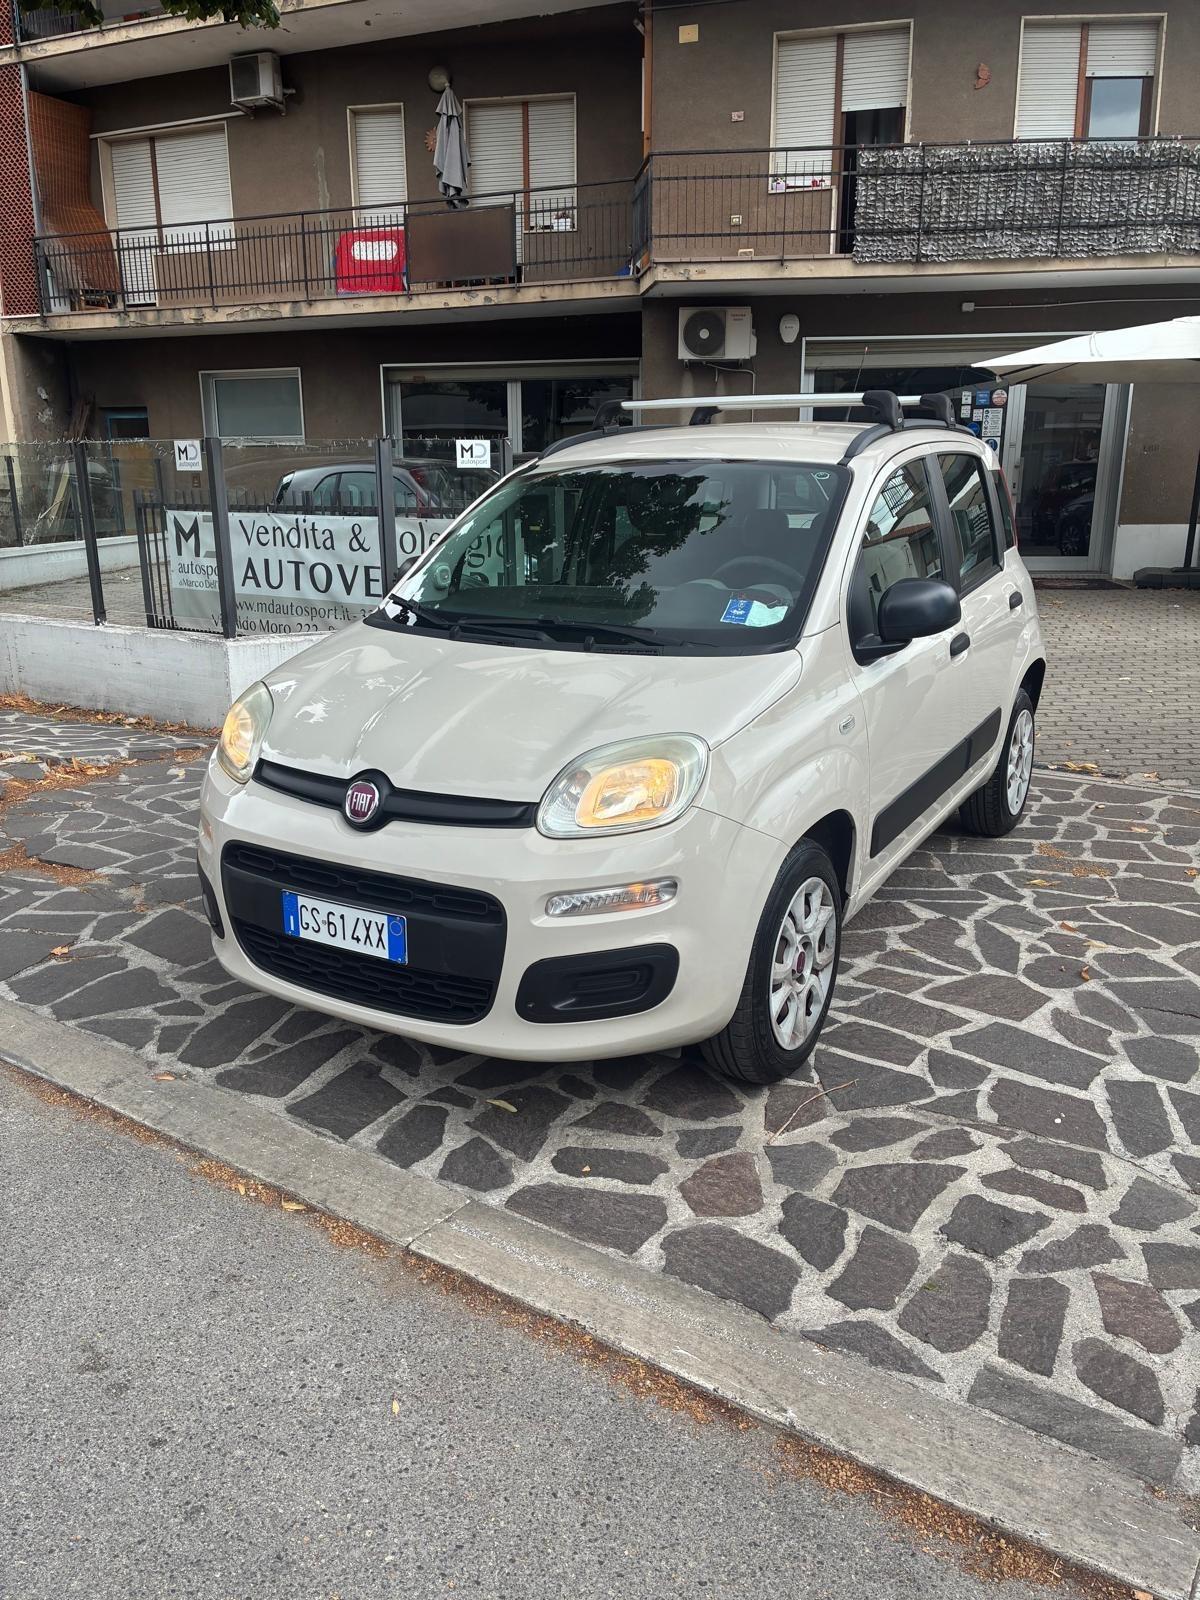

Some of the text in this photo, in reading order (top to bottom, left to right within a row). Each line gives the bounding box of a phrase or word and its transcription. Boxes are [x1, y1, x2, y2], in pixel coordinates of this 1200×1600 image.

[178, 444, 198, 461] MD
[461, 443, 487, 458] MD
[239, 517, 335, 551] Vendita
[348, 523, 371, 552] &
[178, 561, 218, 579] autospo
[241, 557, 382, 598] AUTOVE
[236, 599, 351, 621] ww.mdautosport.it
[260, 618, 291, 633] Moro
[351, 791, 373, 813] FIAT
[326, 911, 387, 950] 614XX
